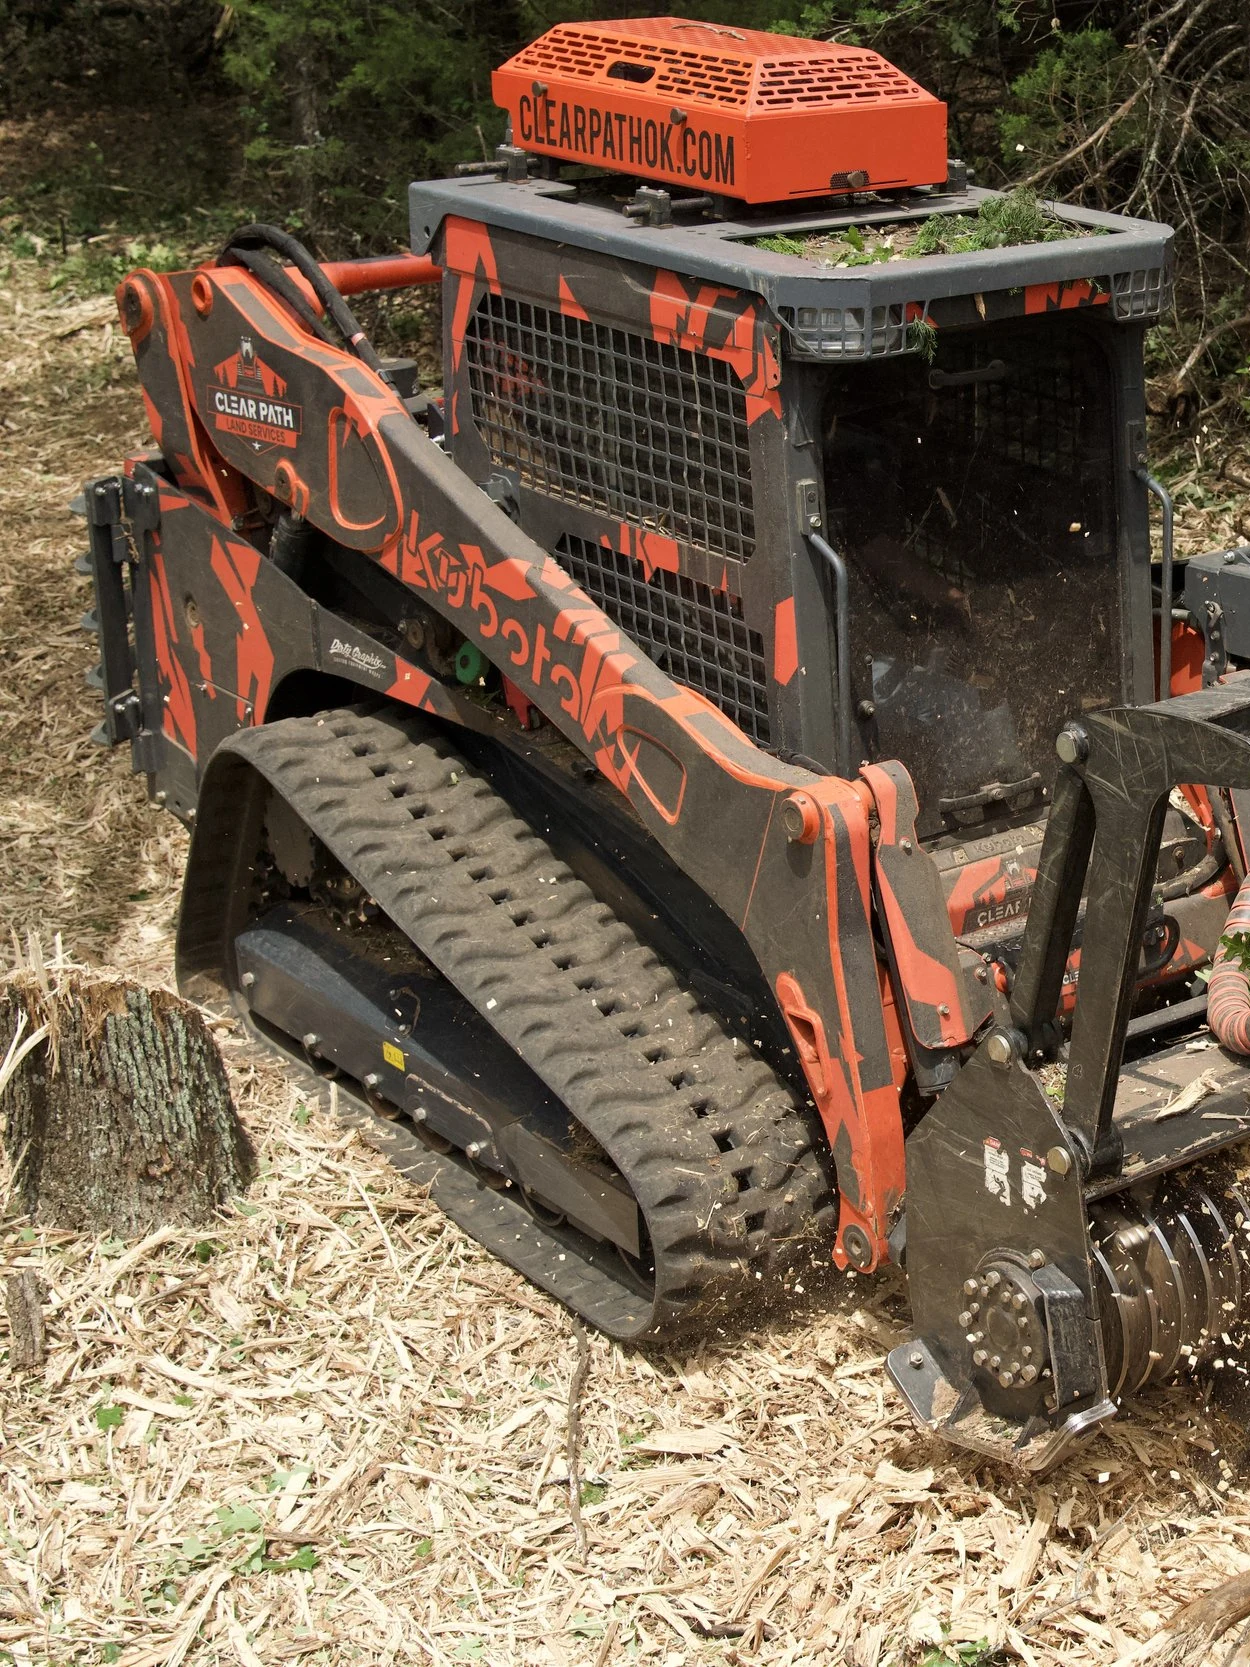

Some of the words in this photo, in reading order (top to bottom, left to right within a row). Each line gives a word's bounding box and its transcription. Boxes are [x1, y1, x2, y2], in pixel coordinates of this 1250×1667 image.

[519, 95, 735, 186] CLEARPATHOK.COM
[215, 392, 257, 419] CLEAR
[259, 402, 293, 428] PATH
[226, 419, 247, 433] LAND
[248, 423, 286, 443] SERVICES
[330, 638, 352, 657] Dirty
[973, 833, 1026, 854] Kubota
